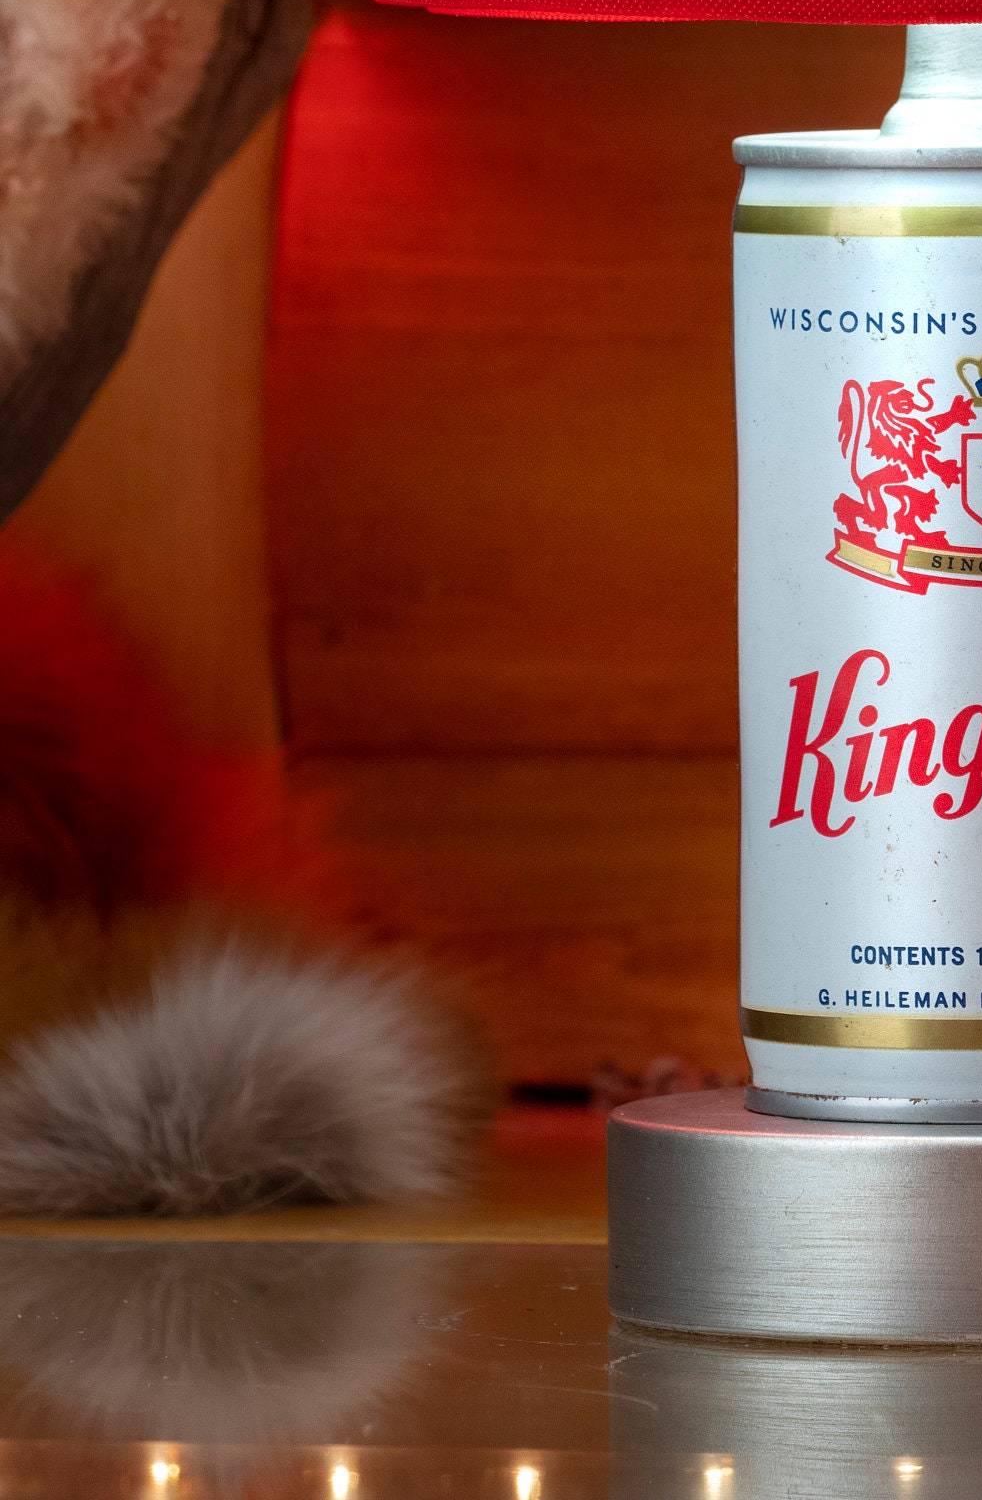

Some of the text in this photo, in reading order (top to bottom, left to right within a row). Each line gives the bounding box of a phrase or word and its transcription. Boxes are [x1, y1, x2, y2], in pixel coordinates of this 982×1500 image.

[769, 306, 978, 336] WISCONSIN'S
[850, 944, 965, 967] CONTENTS
[817, 988, 837, 1007] G.
[845, 989, 967, 1010] HEILEMAN
